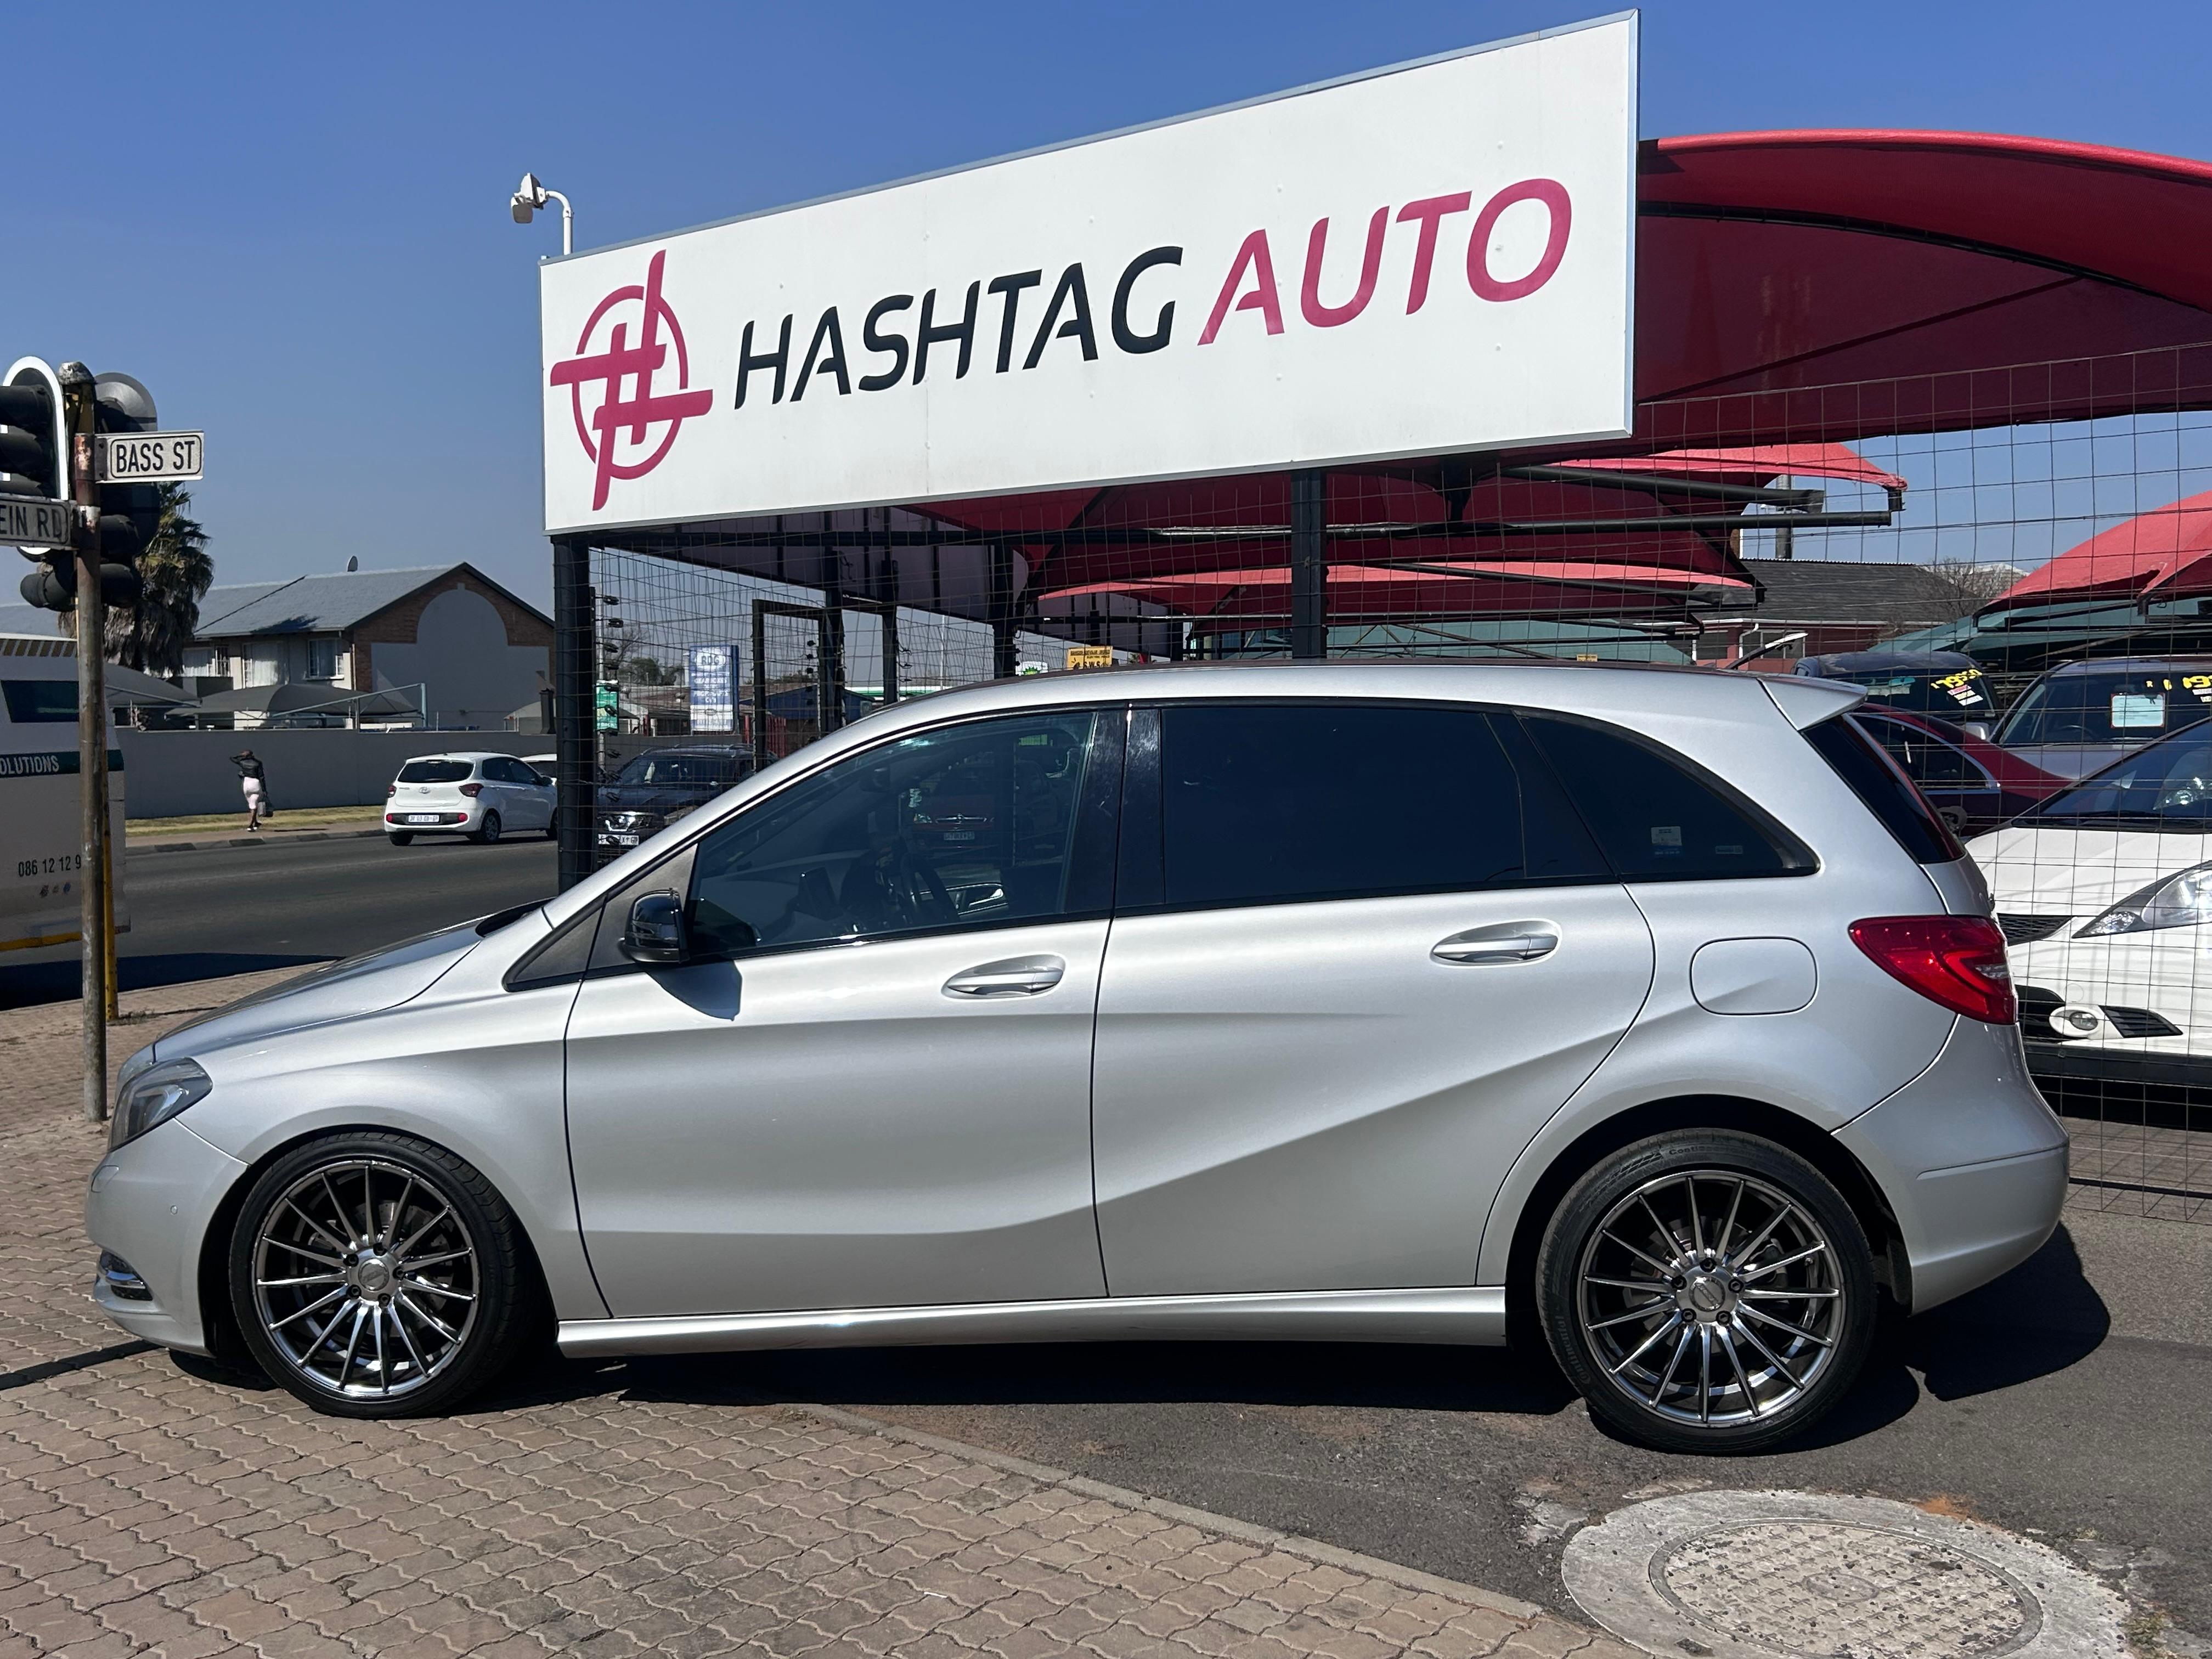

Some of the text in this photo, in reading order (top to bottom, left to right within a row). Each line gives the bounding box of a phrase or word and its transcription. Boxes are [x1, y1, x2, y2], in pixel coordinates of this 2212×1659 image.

[735, 179, 1571, 410] HASHTAG AUTO
[116, 441, 196, 473] BASS ST
[37, 508, 63, 540] RD
[18, 859, 38, 877] 086
[42, 857, 55, 873] 12
[59, 856, 71, 871] 12
